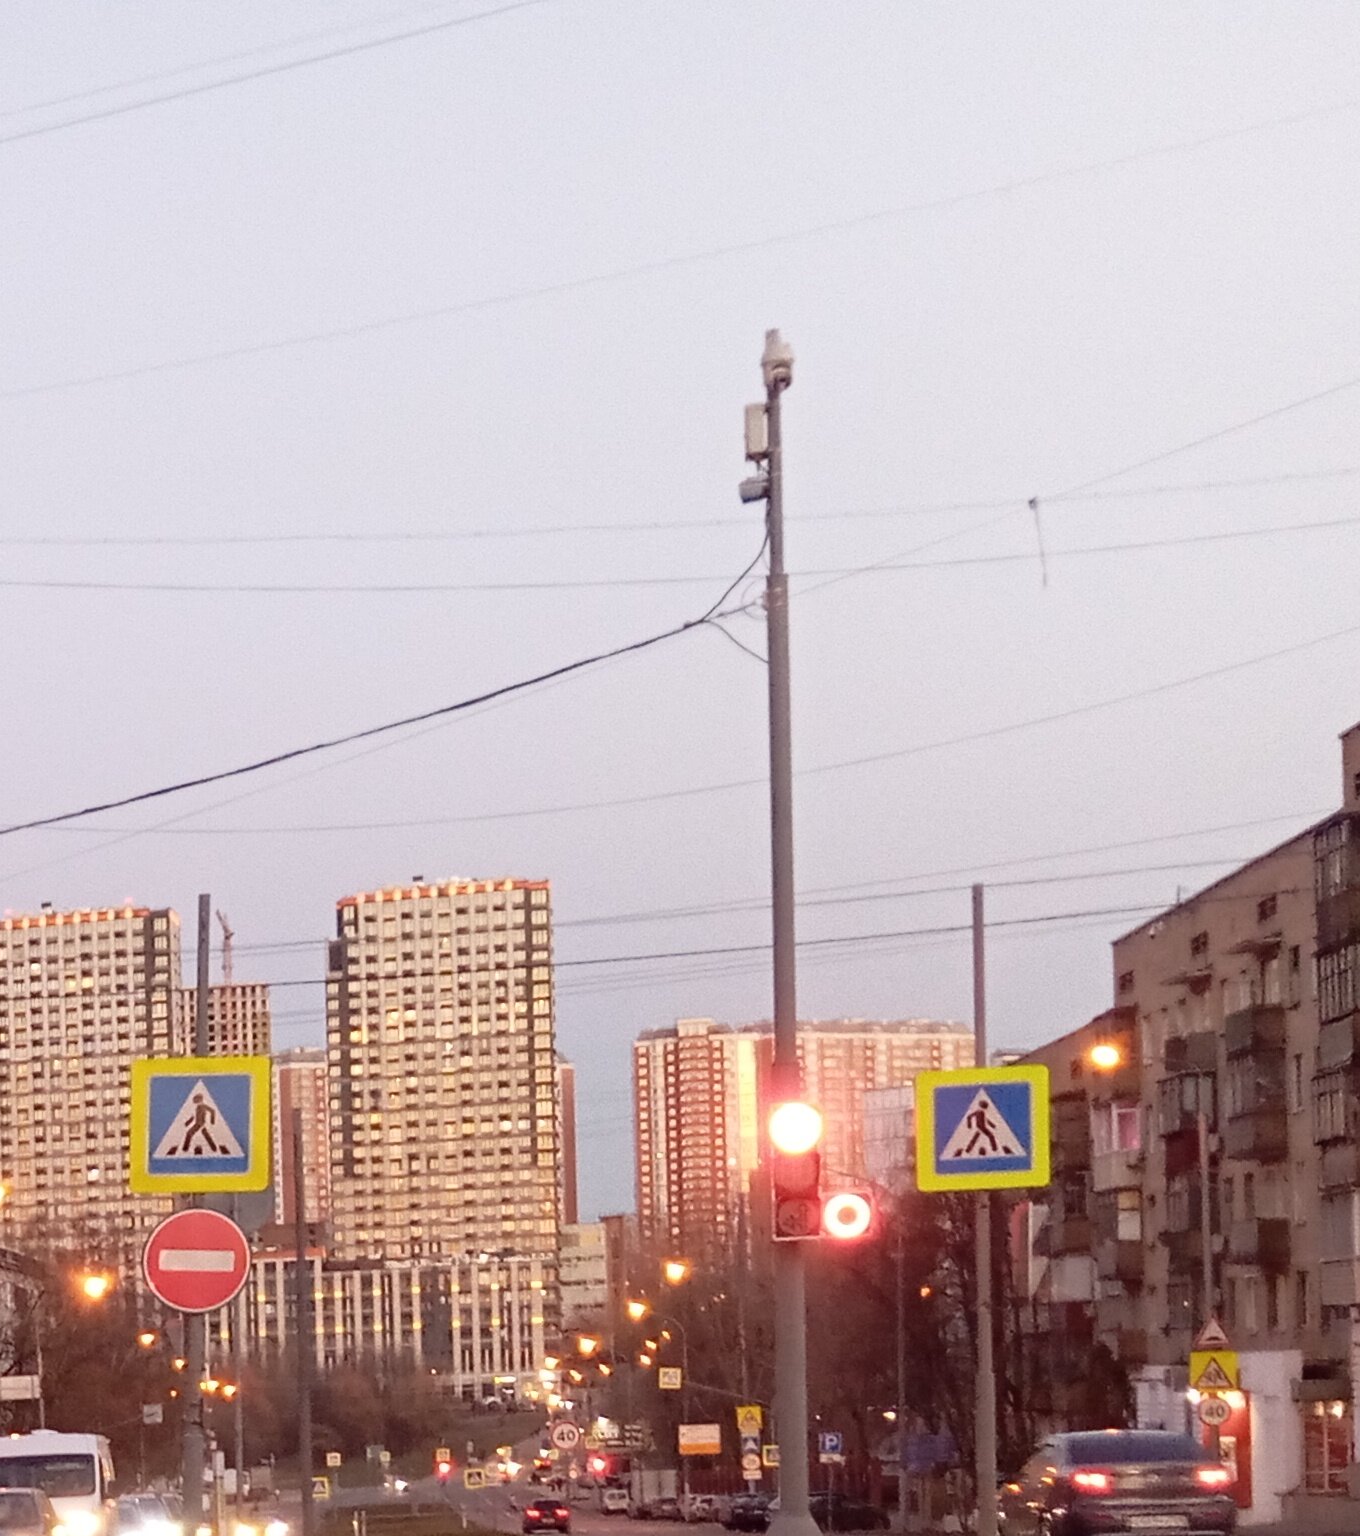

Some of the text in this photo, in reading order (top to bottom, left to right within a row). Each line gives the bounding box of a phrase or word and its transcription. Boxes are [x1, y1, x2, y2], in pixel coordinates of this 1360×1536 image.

[1205, 1405, 1225, 1418] 40
[557, 1429, 576, 1442] 40
[826, 1435, 838, 1451] P
